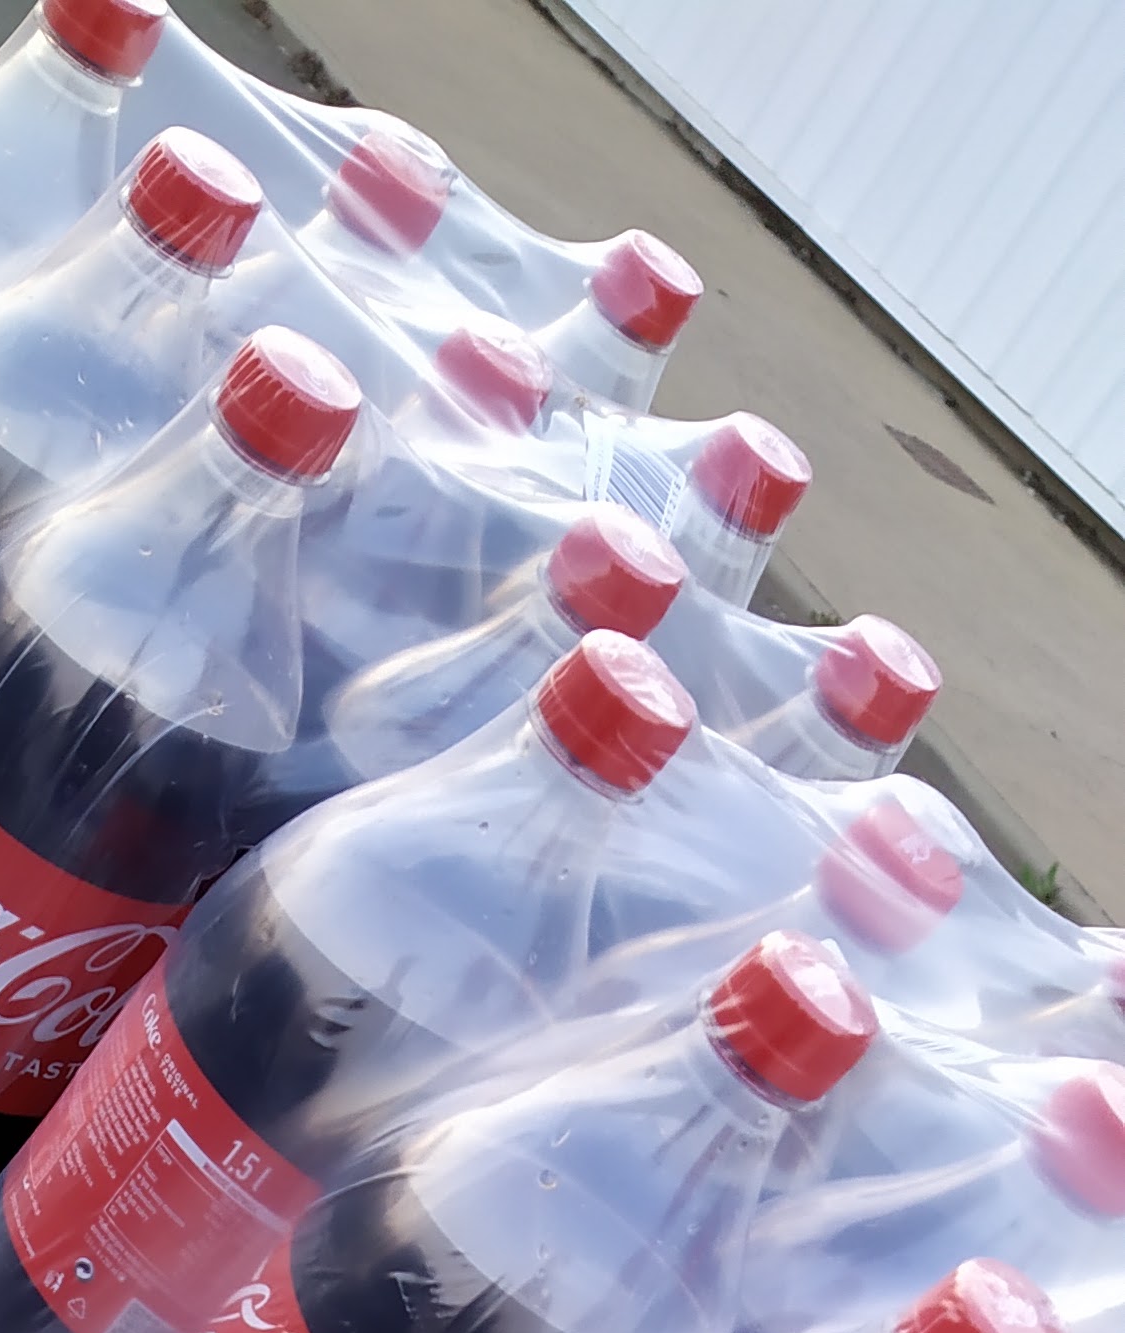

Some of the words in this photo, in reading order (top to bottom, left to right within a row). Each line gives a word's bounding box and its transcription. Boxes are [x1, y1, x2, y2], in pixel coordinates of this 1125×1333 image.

[141, 993, 162, 1050] Coke
[6, 1051, 82, 1080] TAST
[159, 1059, 183, 1097] TASTE
[162, 1053, 200, 1109] ORIGINAL
